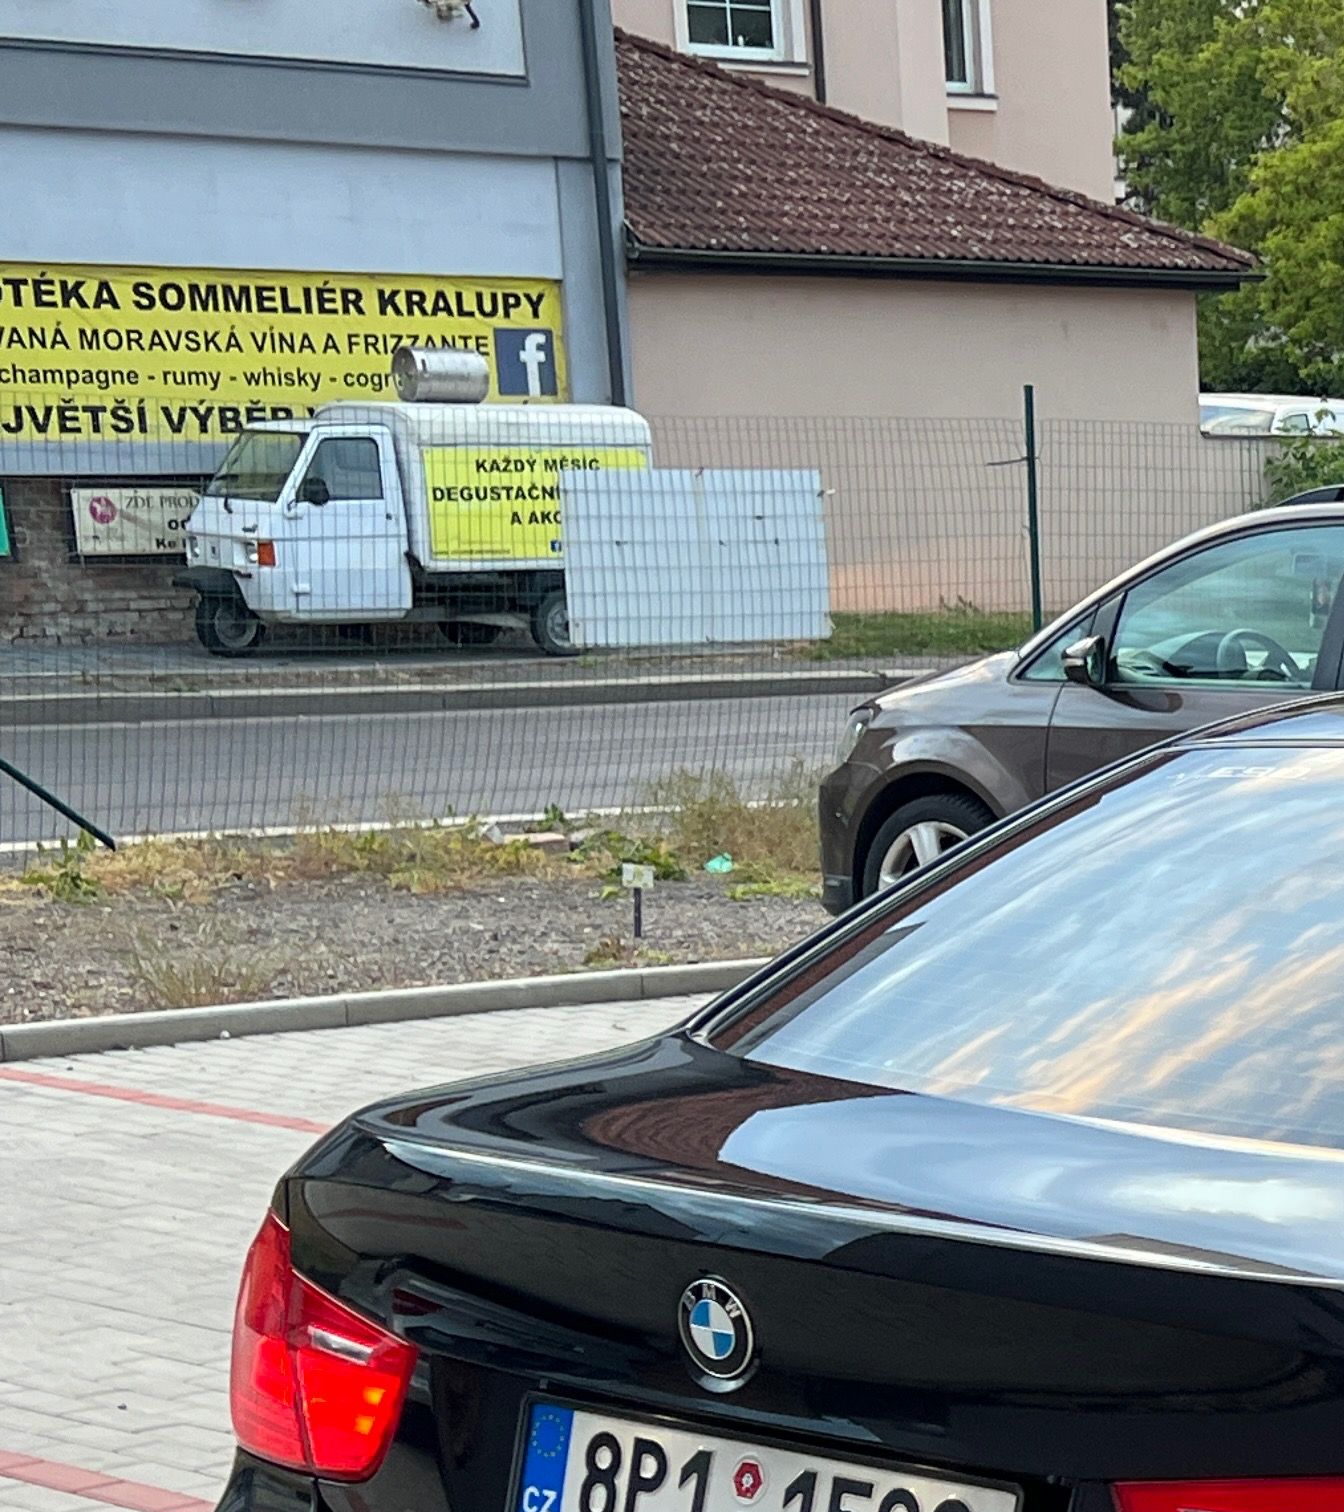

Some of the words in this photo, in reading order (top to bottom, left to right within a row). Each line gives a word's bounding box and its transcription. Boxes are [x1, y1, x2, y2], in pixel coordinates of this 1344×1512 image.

[0, 271, 121, 309] TÉKA
[132, 280, 365, 315] SOMMELIÉR
[377, 288, 545, 319] KRALUPY
[79, 324, 244, 353] MORAVSKÁ
[250, 326, 317, 354] VÍNA
[322, 333, 340, 355] A
[0, 363, 139, 389] champagne
[162, 369, 221, 391] rumy
[243, 366, 321, 392] whisky
[2, 397, 148, 434] JVĚTŠÍ
[475, 454, 537, 473] KAŽDÝ
[511, 511, 522, 525] A
[683, 1283, 742, 1319] BMW
